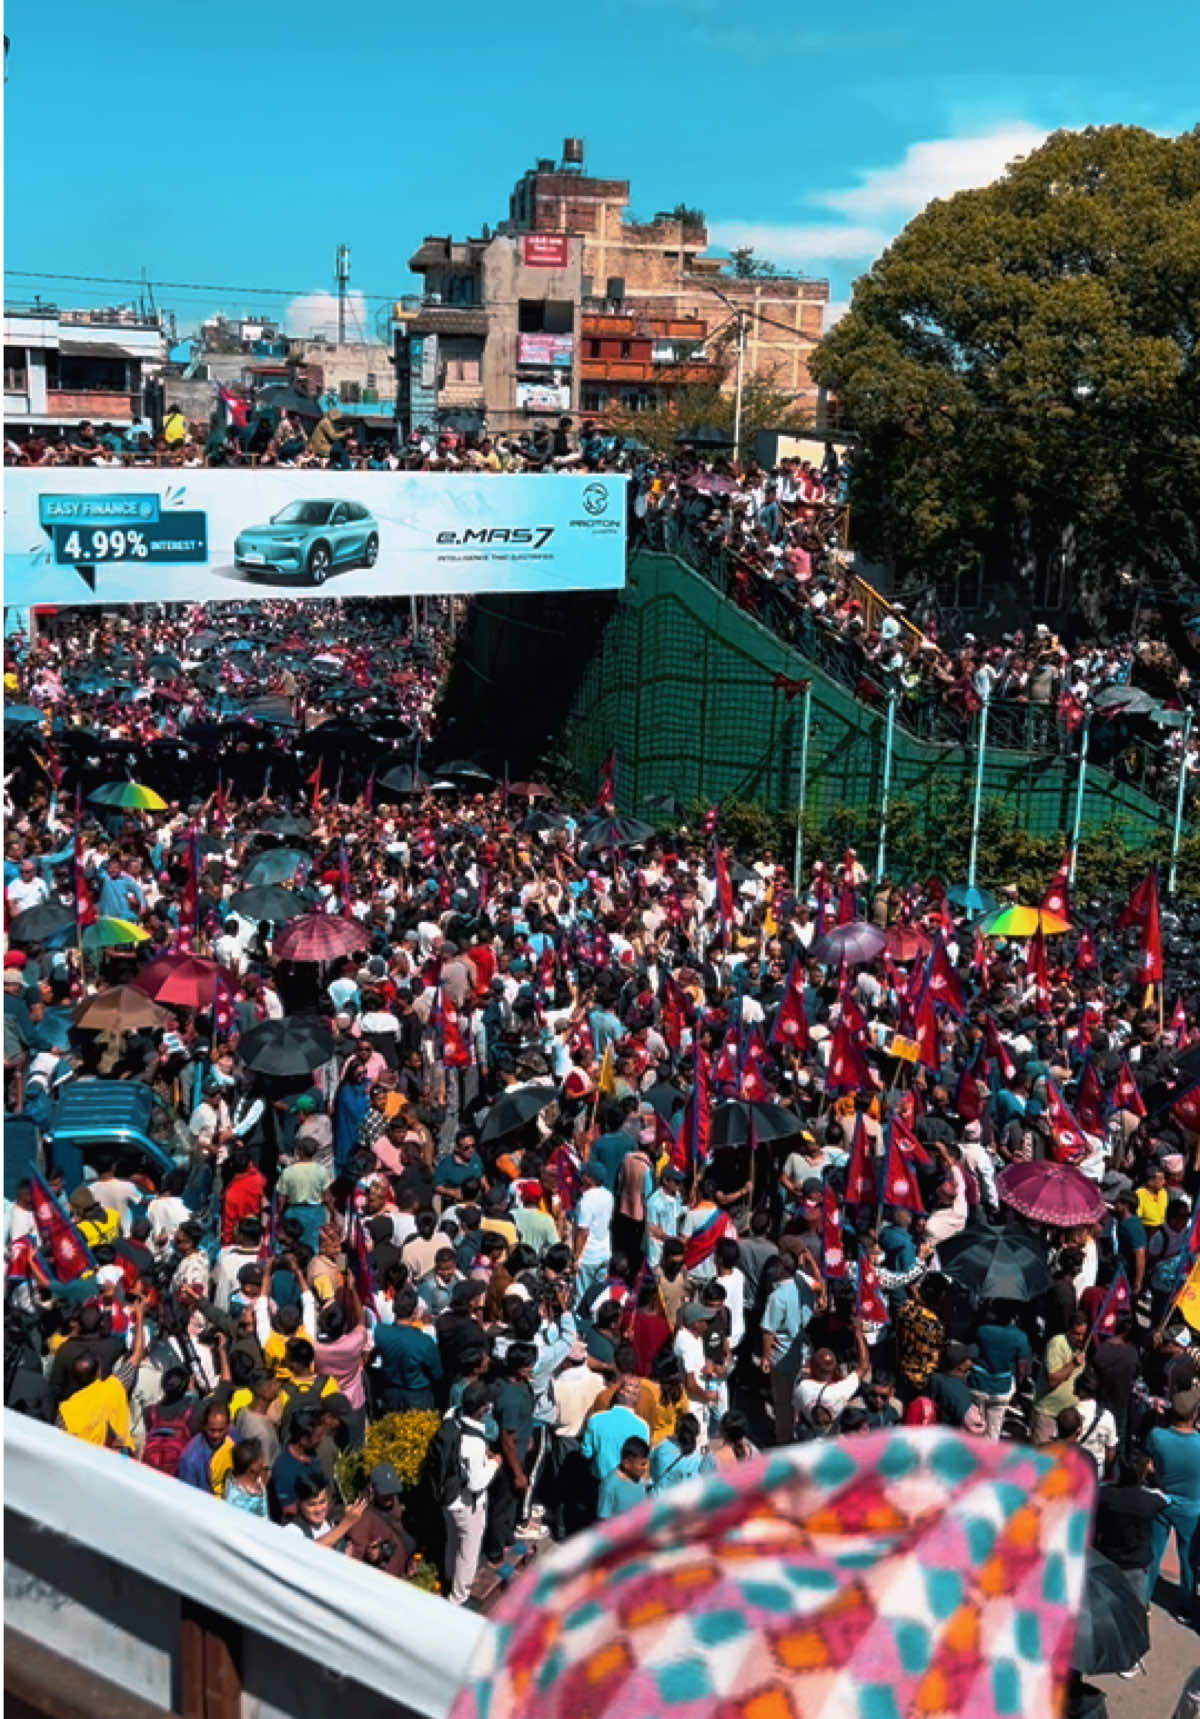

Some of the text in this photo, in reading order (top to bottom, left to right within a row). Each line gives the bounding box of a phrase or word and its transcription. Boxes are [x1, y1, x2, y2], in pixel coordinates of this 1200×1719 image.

[47, 502, 80, 517] EASY
[85, 502, 137, 517] FINANCE
[64, 530, 149, 559] 4.99%
